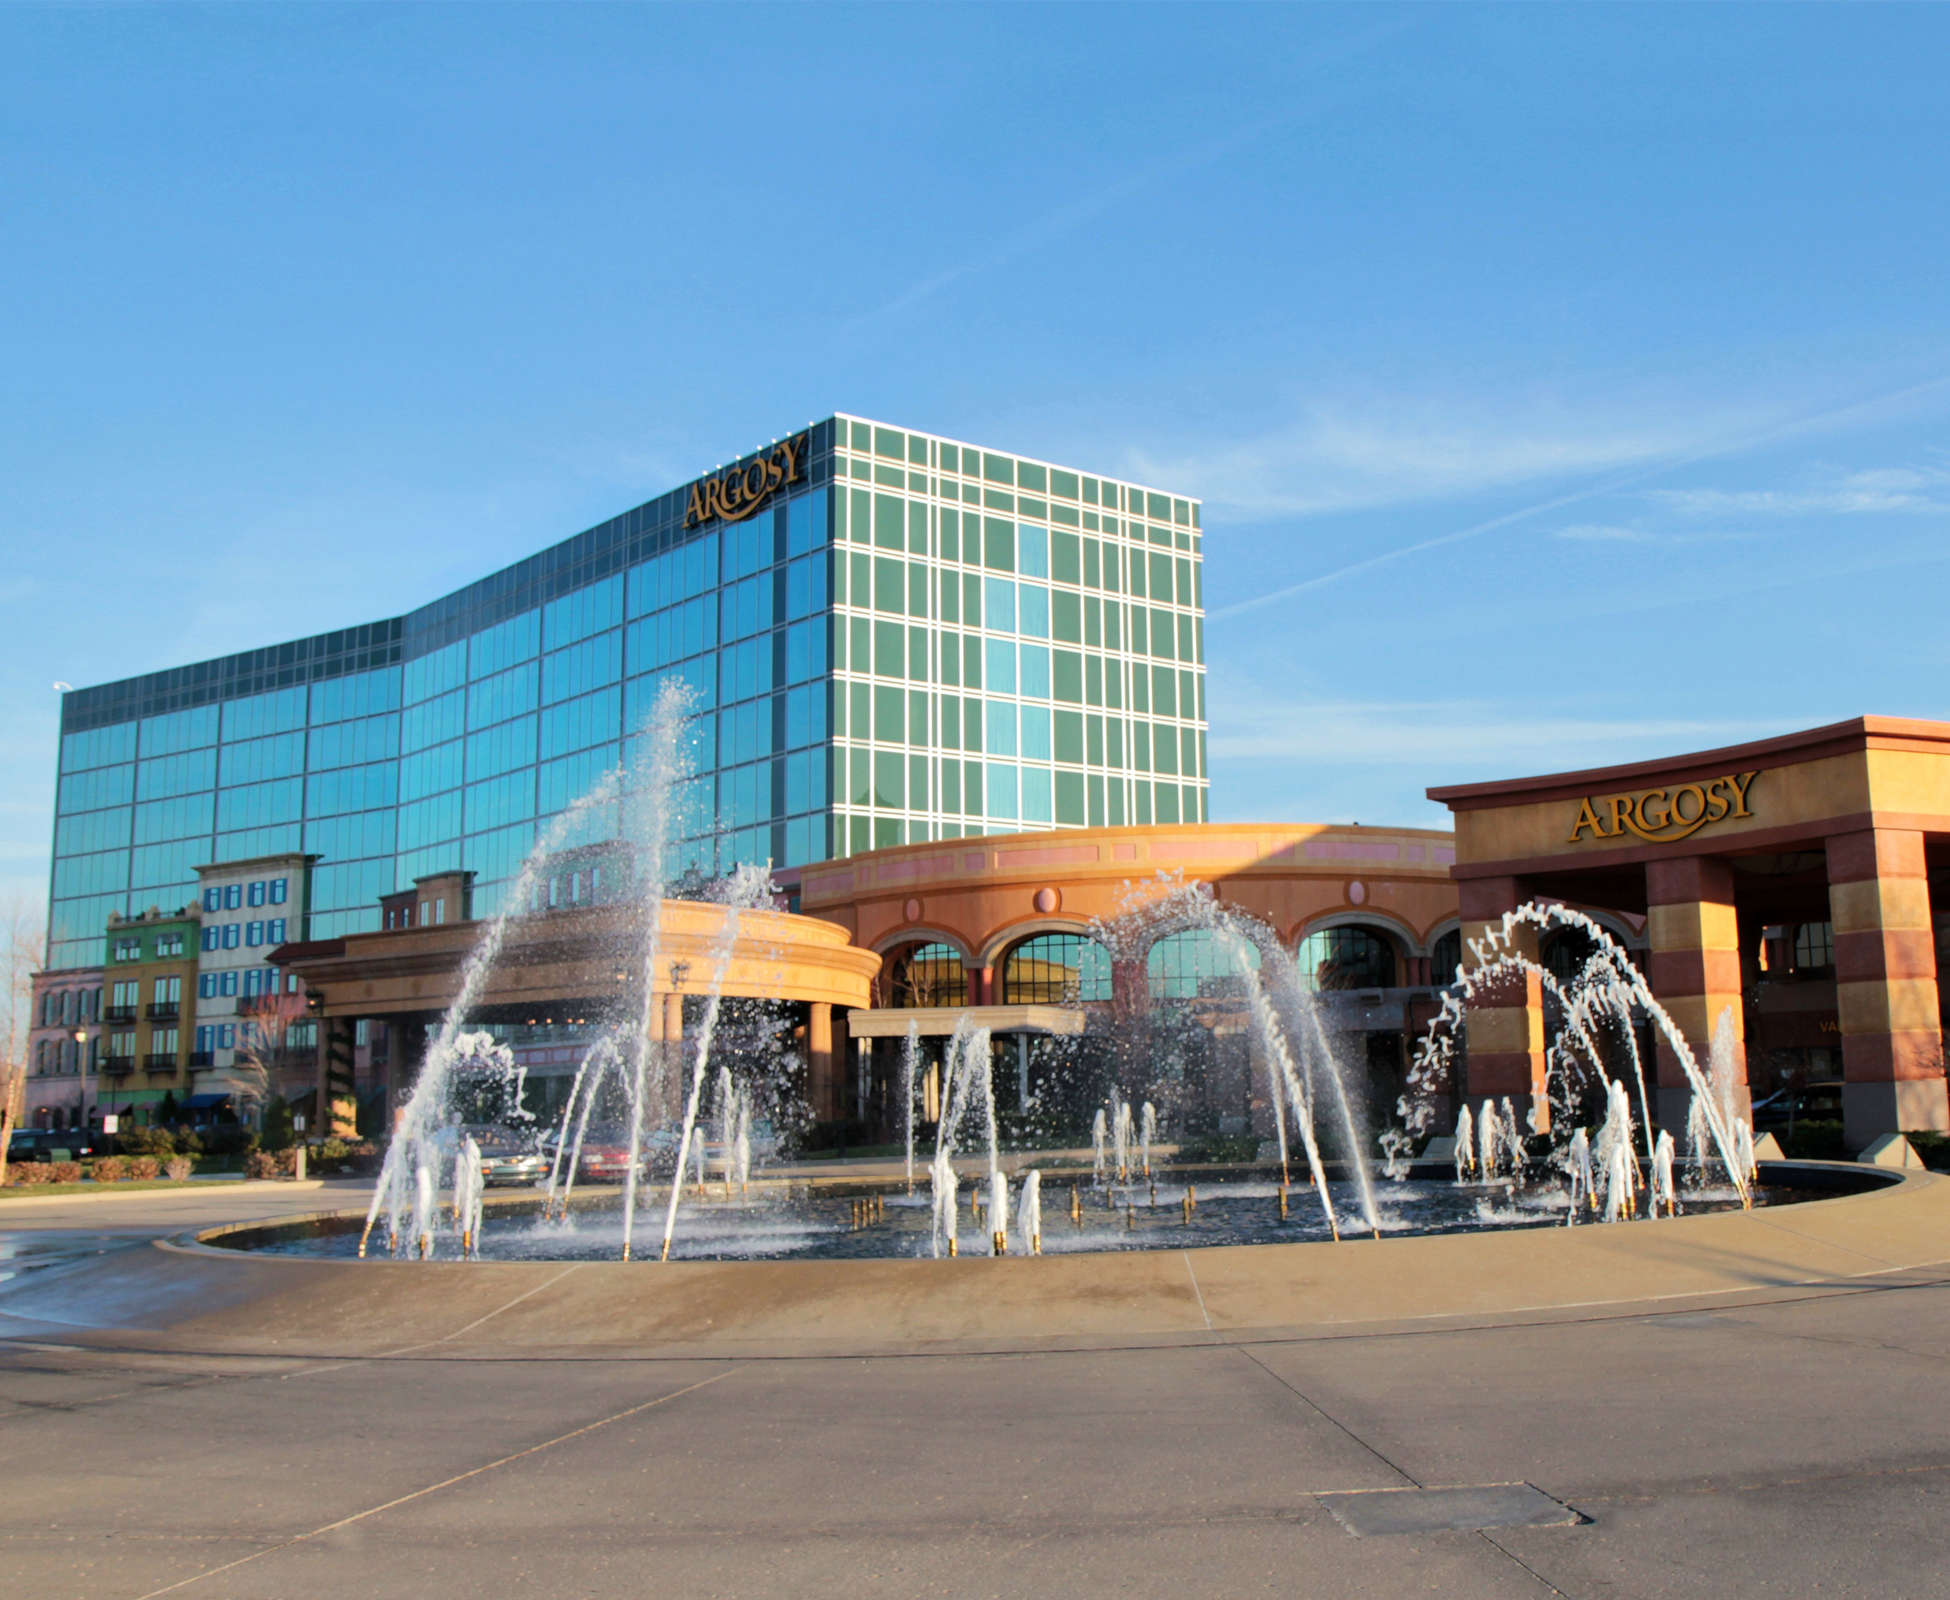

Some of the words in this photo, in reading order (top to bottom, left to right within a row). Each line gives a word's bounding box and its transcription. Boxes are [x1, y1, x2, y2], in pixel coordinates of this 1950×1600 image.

[682, 433, 806, 529] ARGOSY
[1568, 771, 1758, 842] ARGOSY
[1819, 1020, 1840, 1033] VA
